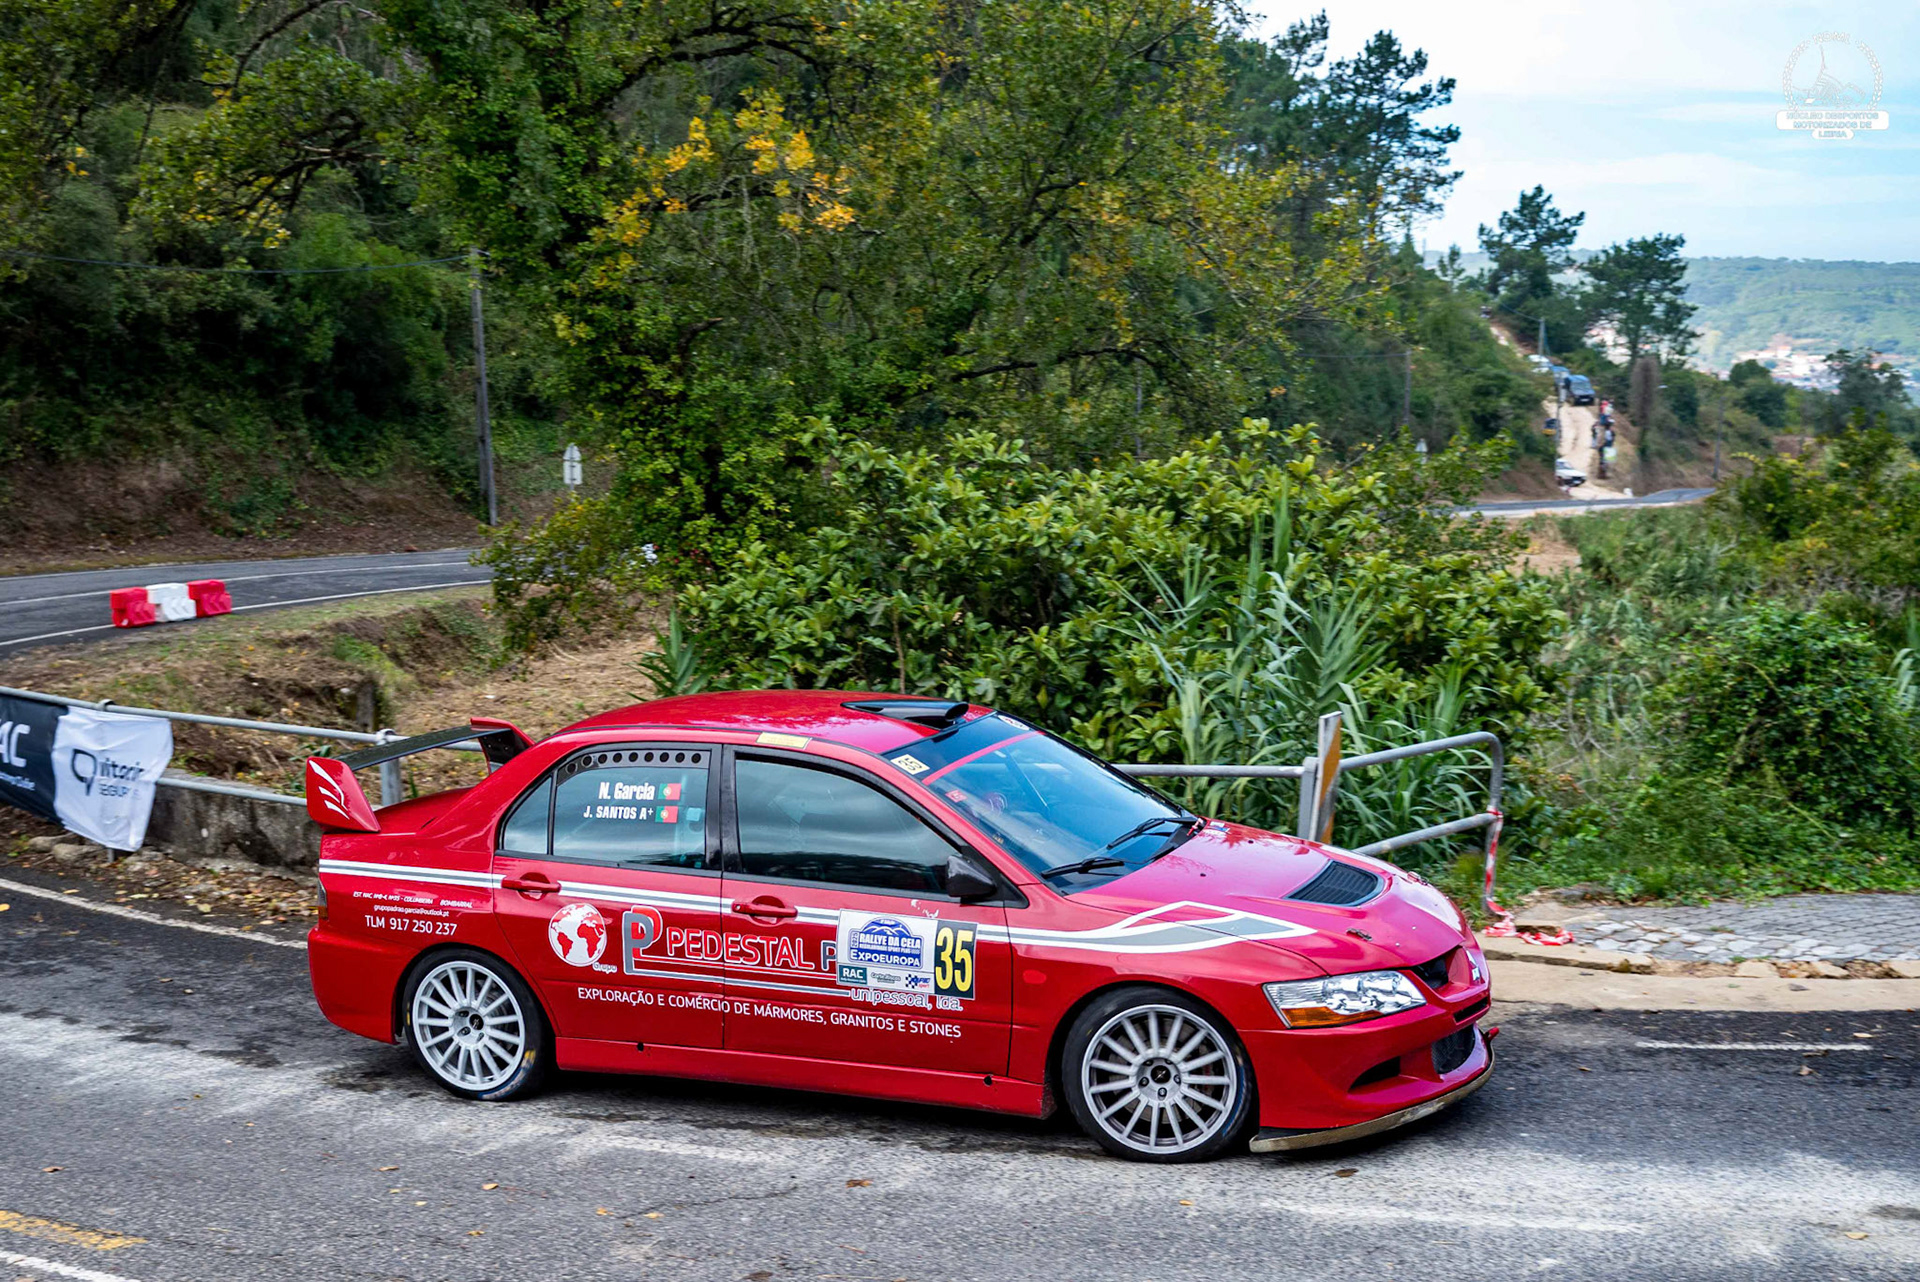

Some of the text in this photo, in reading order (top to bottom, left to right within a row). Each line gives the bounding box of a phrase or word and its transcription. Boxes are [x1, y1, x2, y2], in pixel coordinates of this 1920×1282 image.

[598, 781, 655, 800] N. Garcia
[583, 805, 593, 818] J.
[596, 805, 637, 819] SANTOS
[440, 899, 473, 909] BOMBARRAL
[365, 915, 457, 936] TLM 917 250 237
[667, 926, 815, 970] PEDESTAL
[859, 933, 921, 948] RALLYE DA CELA
[850, 949, 921, 967] EXPOEUROPA
[935, 926, 974, 992] 35
[592, 962, 618, 974] Grupo
[842, 967, 864, 979] RAC
[850, 987, 964, 1012] unipessoal, lda.
[577, 986, 962, 1038] EXPLORAÇÃO E COMÉRCIO DE MÁRMORES, GRANITOS E STONES
